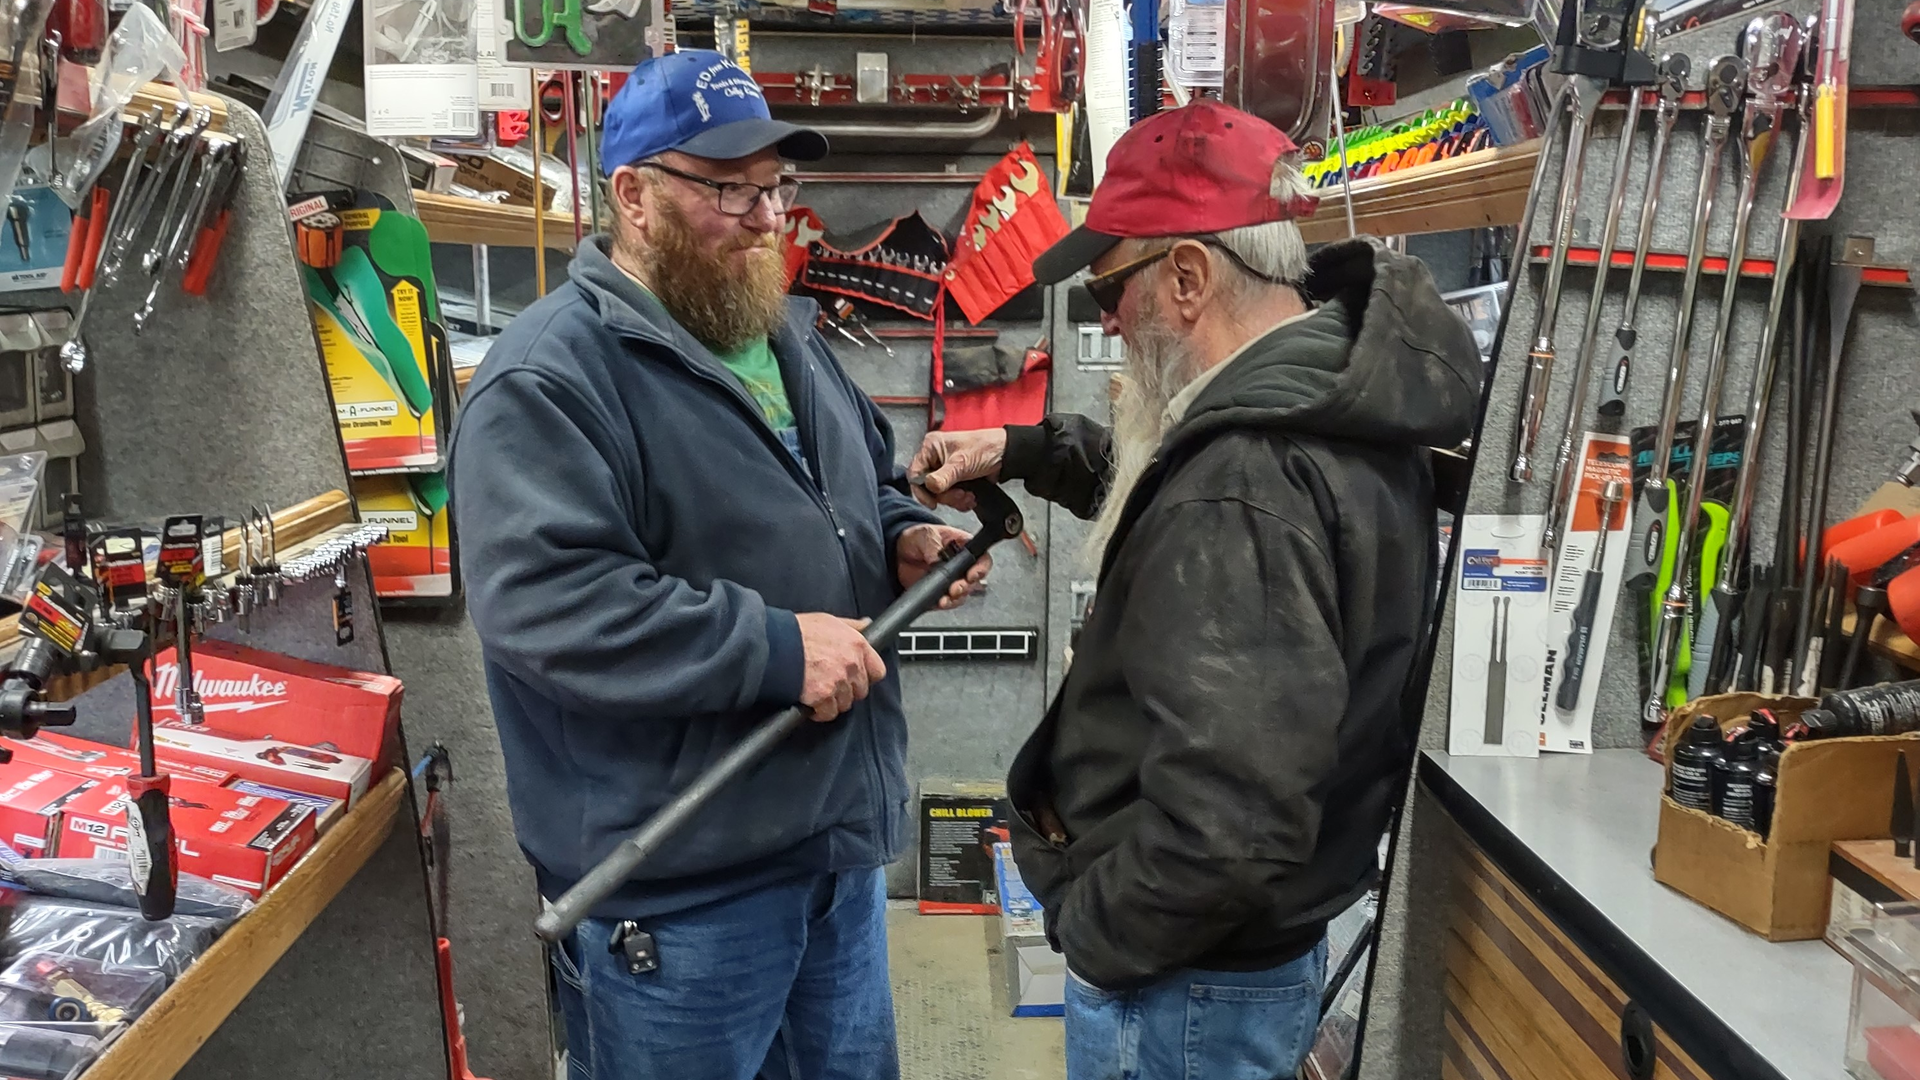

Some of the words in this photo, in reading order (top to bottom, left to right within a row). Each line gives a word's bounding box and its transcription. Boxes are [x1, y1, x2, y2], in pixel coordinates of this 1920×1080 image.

[290, 200, 324, 218] RIGINAL
[155, 662, 286, 699] Mlwaukee
[929, 808, 954, 817] CHILL
[956, 808, 993, 817] BLOWER
[73, 819, 106, 835] M12
